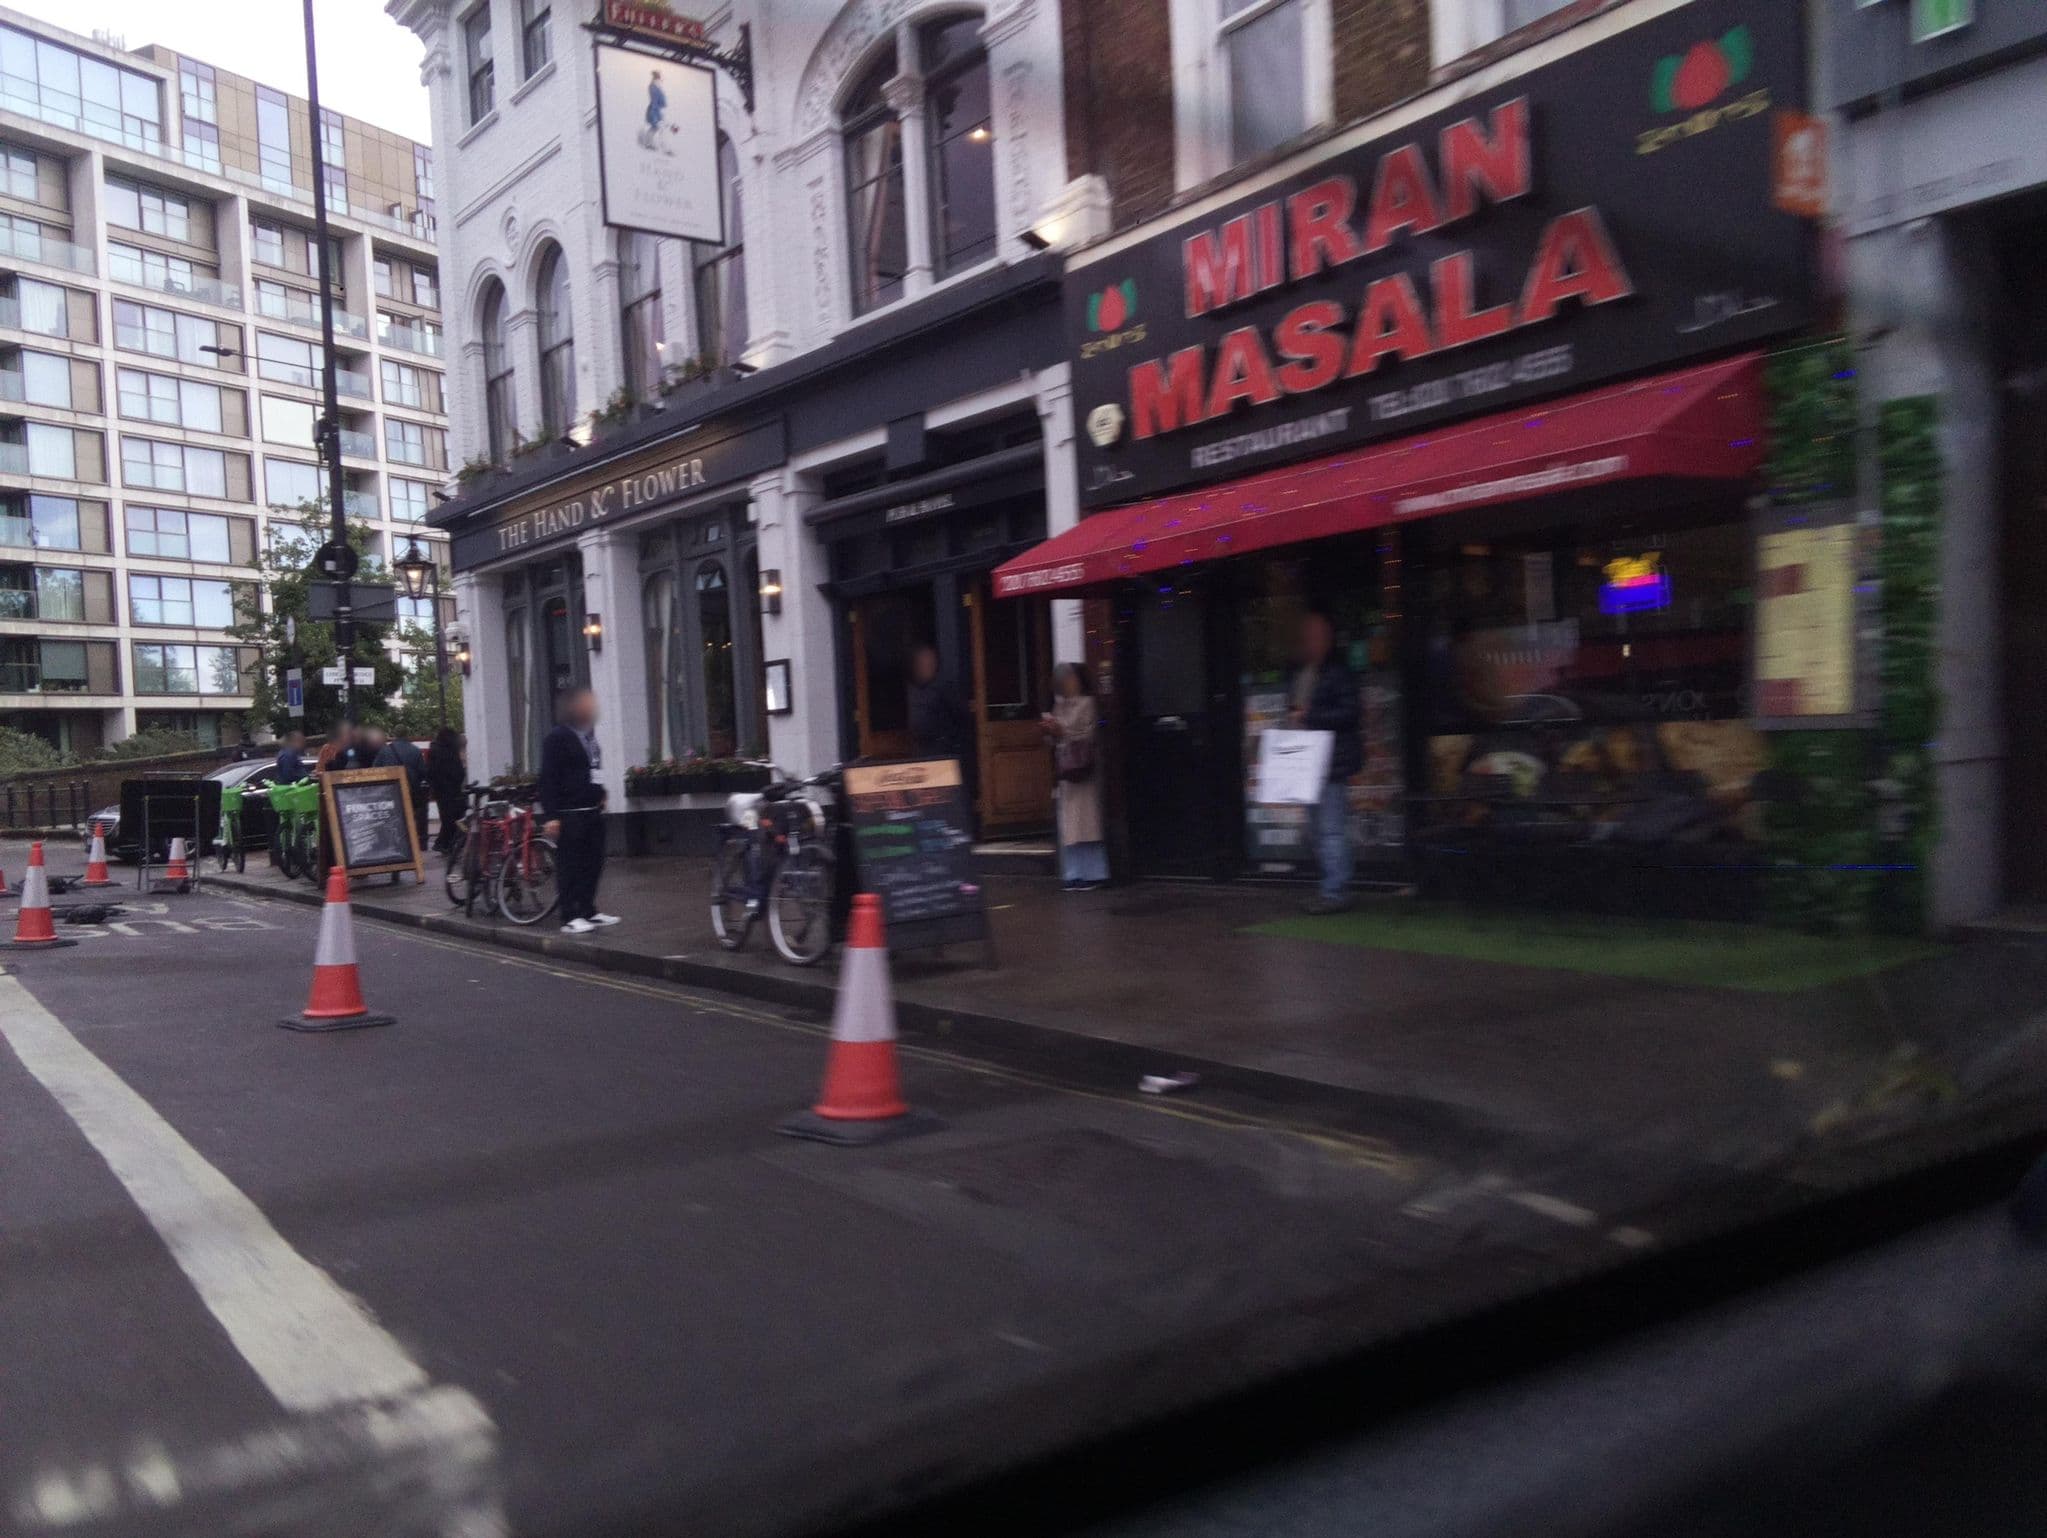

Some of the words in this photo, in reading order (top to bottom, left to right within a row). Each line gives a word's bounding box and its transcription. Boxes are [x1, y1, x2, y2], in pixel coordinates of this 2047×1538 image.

[1184, 96, 1531, 318] MIRAN
[1127, 205, 1633, 441] MASALA
[498, 521, 528, 550] THE
[534, 502, 585, 538] HAND
[590, 486, 615, 519] &
[621, 458, 706, 509] FLOWER
